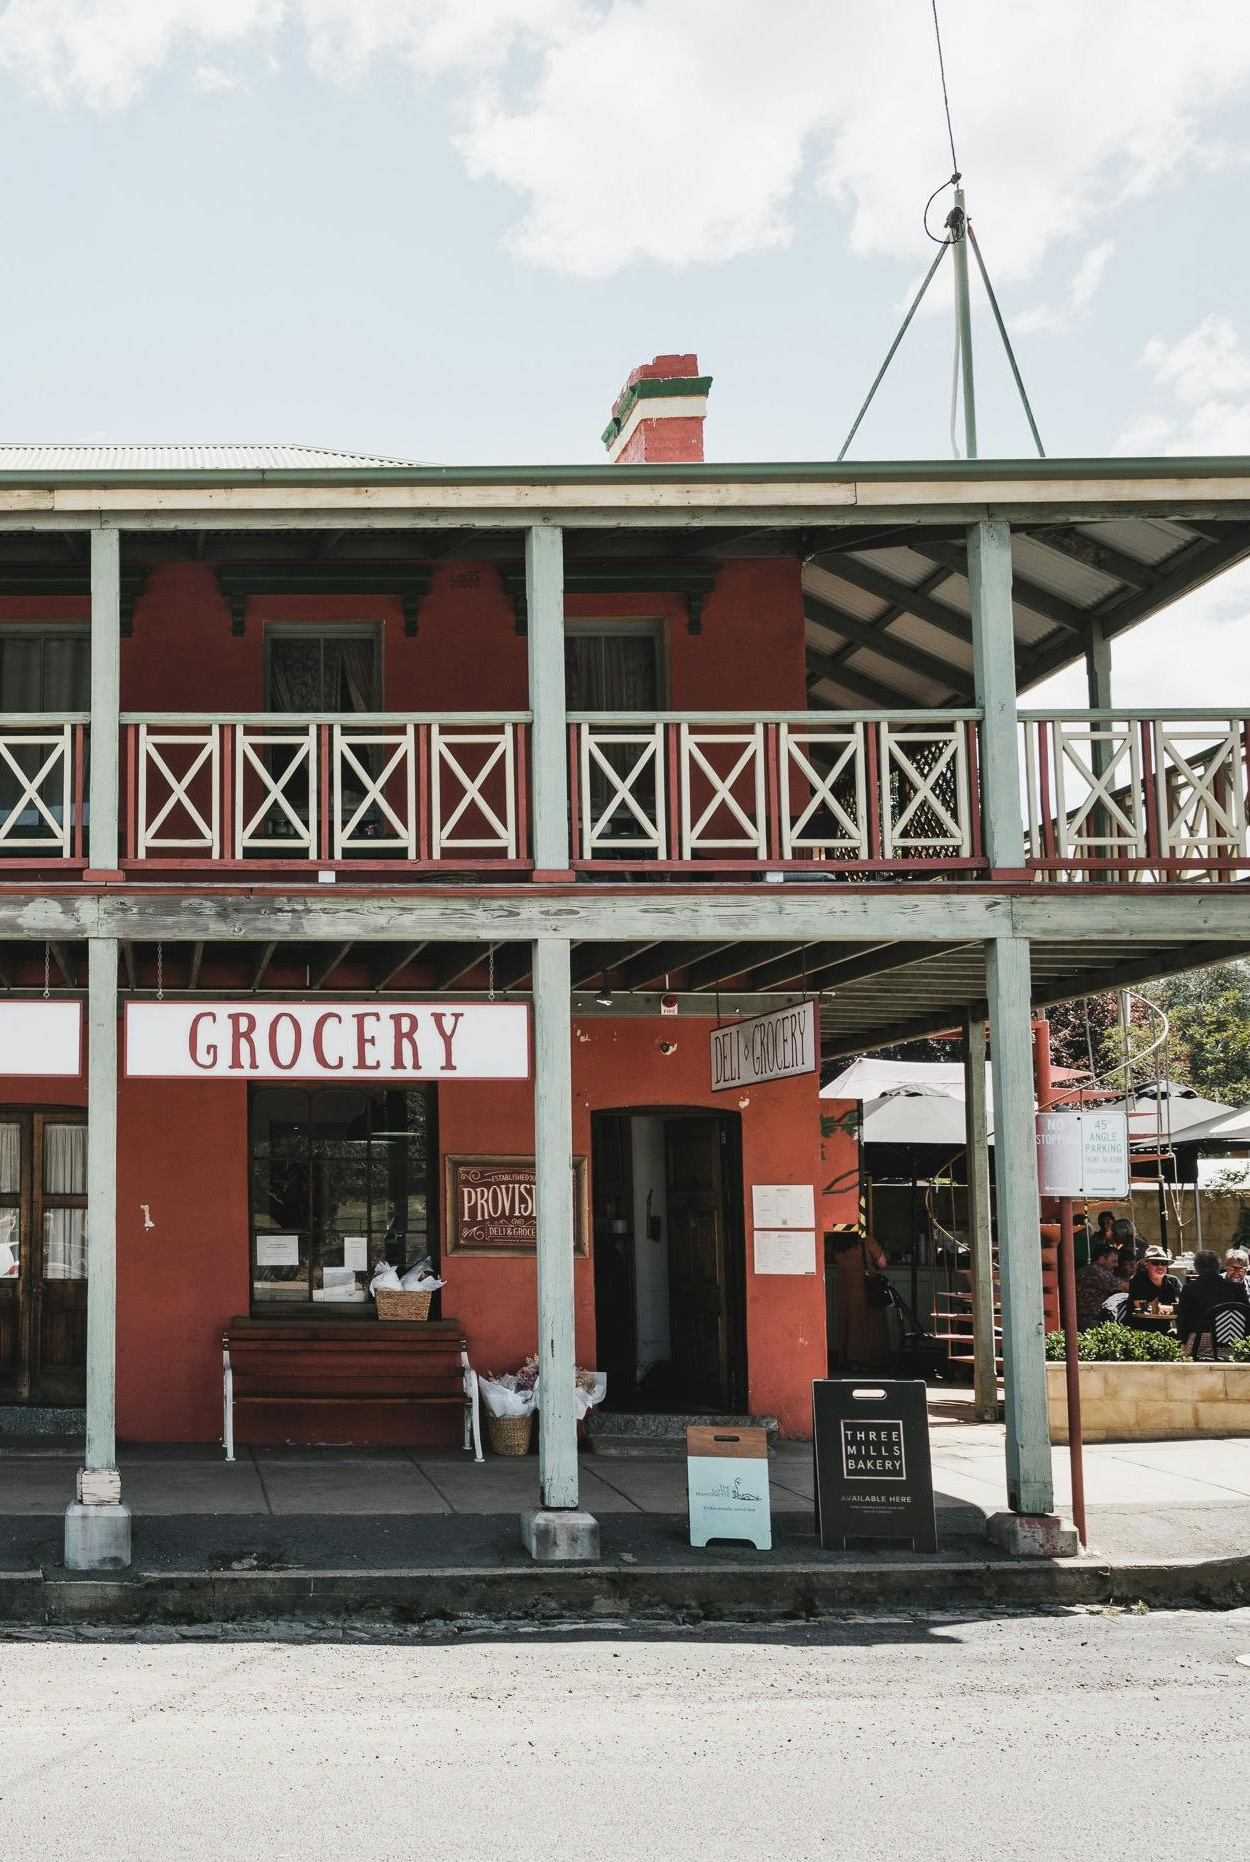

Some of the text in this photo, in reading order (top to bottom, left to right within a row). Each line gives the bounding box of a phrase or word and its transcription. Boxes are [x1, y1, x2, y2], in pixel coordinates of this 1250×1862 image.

[189, 1011, 465, 1071] GROCERY
[714, 1010, 806, 1084] DELI GROCERY
[1047, 1118, 1065, 1131] NO
[1089, 1132, 1118, 1142] ANGLE
[1085, 1144, 1122, 1153] PARKING
[491, 1173, 530, 1182] ESTABLISHED
[462, 1184, 537, 1221] PROVISI
[489, 1226, 537, 1237] DELI & GROCE
[845, 1431, 900, 1441] THREE
[847, 1445, 901, 1456] MILLS
[848, 1459, 901, 1470] BAKERY
